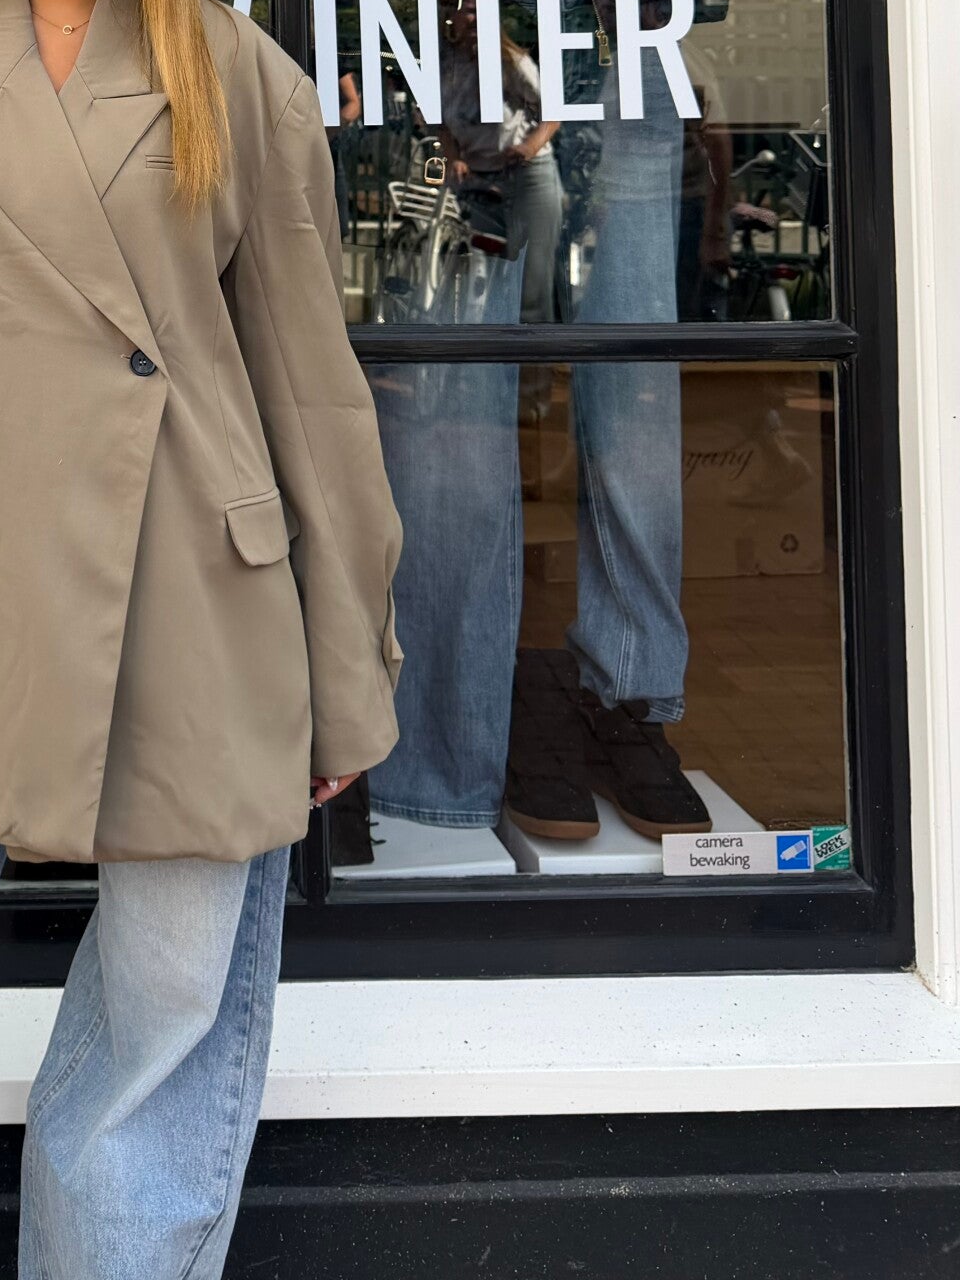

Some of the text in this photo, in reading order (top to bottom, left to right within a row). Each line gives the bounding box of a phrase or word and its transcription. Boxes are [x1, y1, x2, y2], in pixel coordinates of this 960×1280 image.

[695, 836, 743, 849] camera
[815, 834, 843, 853] LOCK
[817, 840, 848, 859] WELL
[689, 852, 751, 870] bewaking
